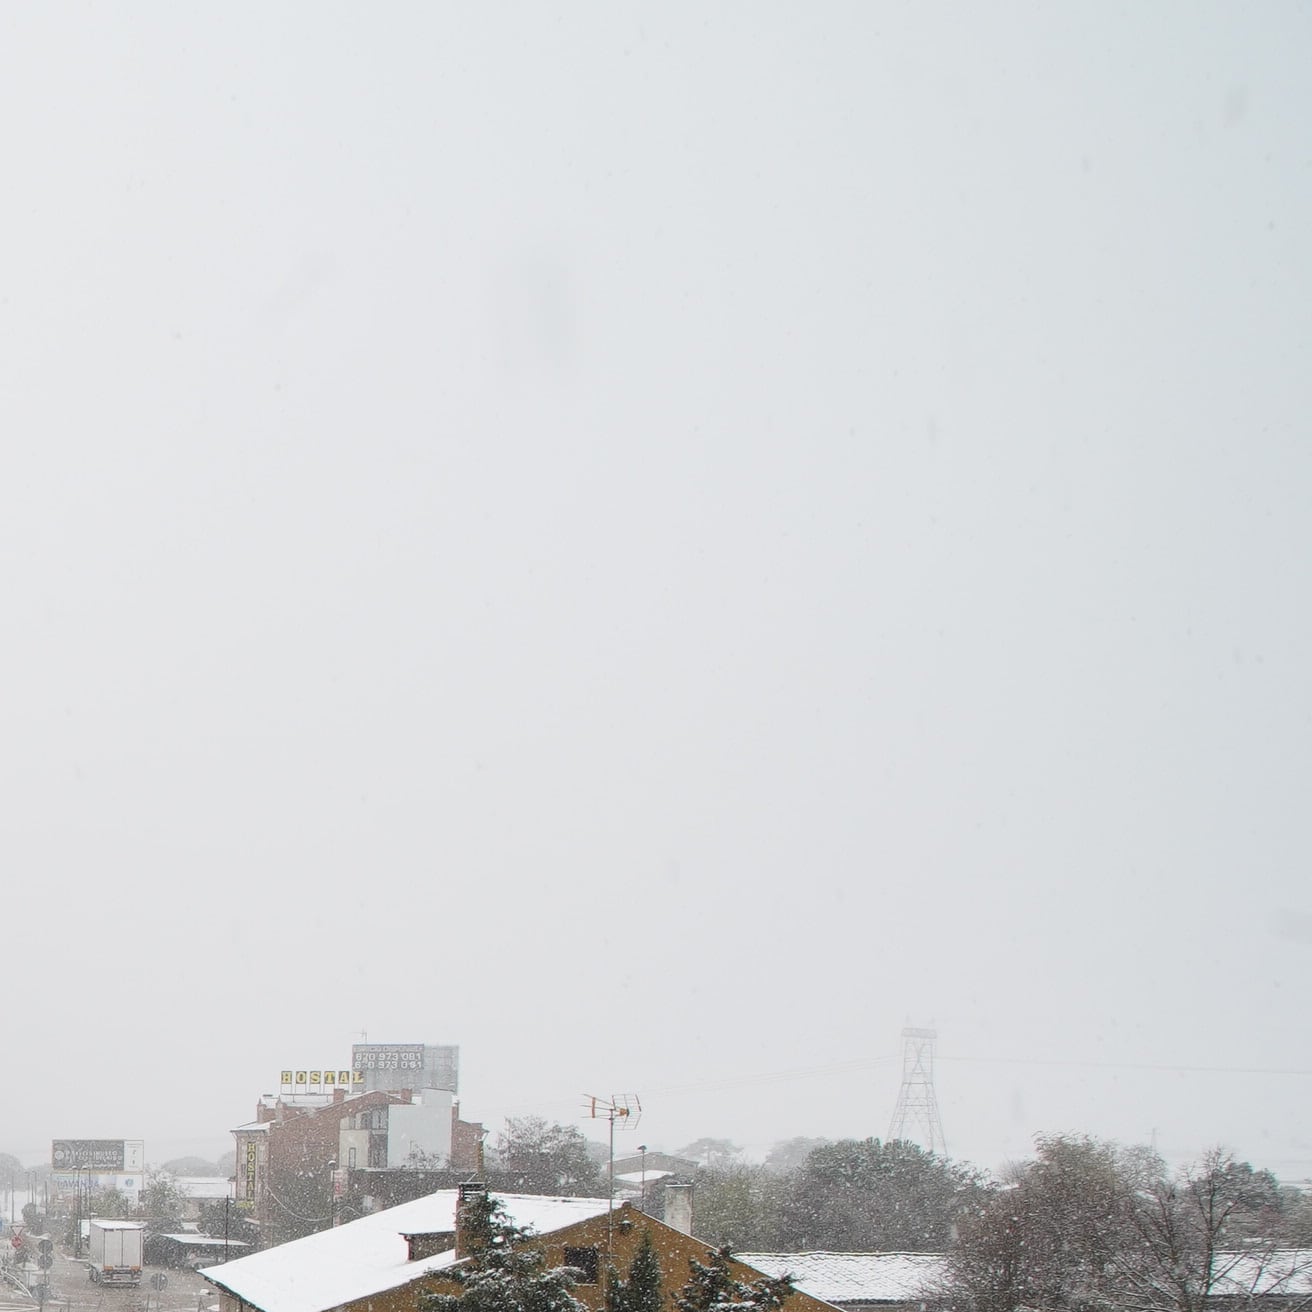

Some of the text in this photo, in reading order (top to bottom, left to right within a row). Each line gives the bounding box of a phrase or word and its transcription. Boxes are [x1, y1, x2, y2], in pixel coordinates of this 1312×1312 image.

[378, 1052, 399, 1061] 973
[354, 1061, 375, 1069] 60
[378, 1061, 398, 1069] 973
[281, 1071, 365, 1085] HOSTAL
[247, 1143, 256, 1201] HOSTAL
